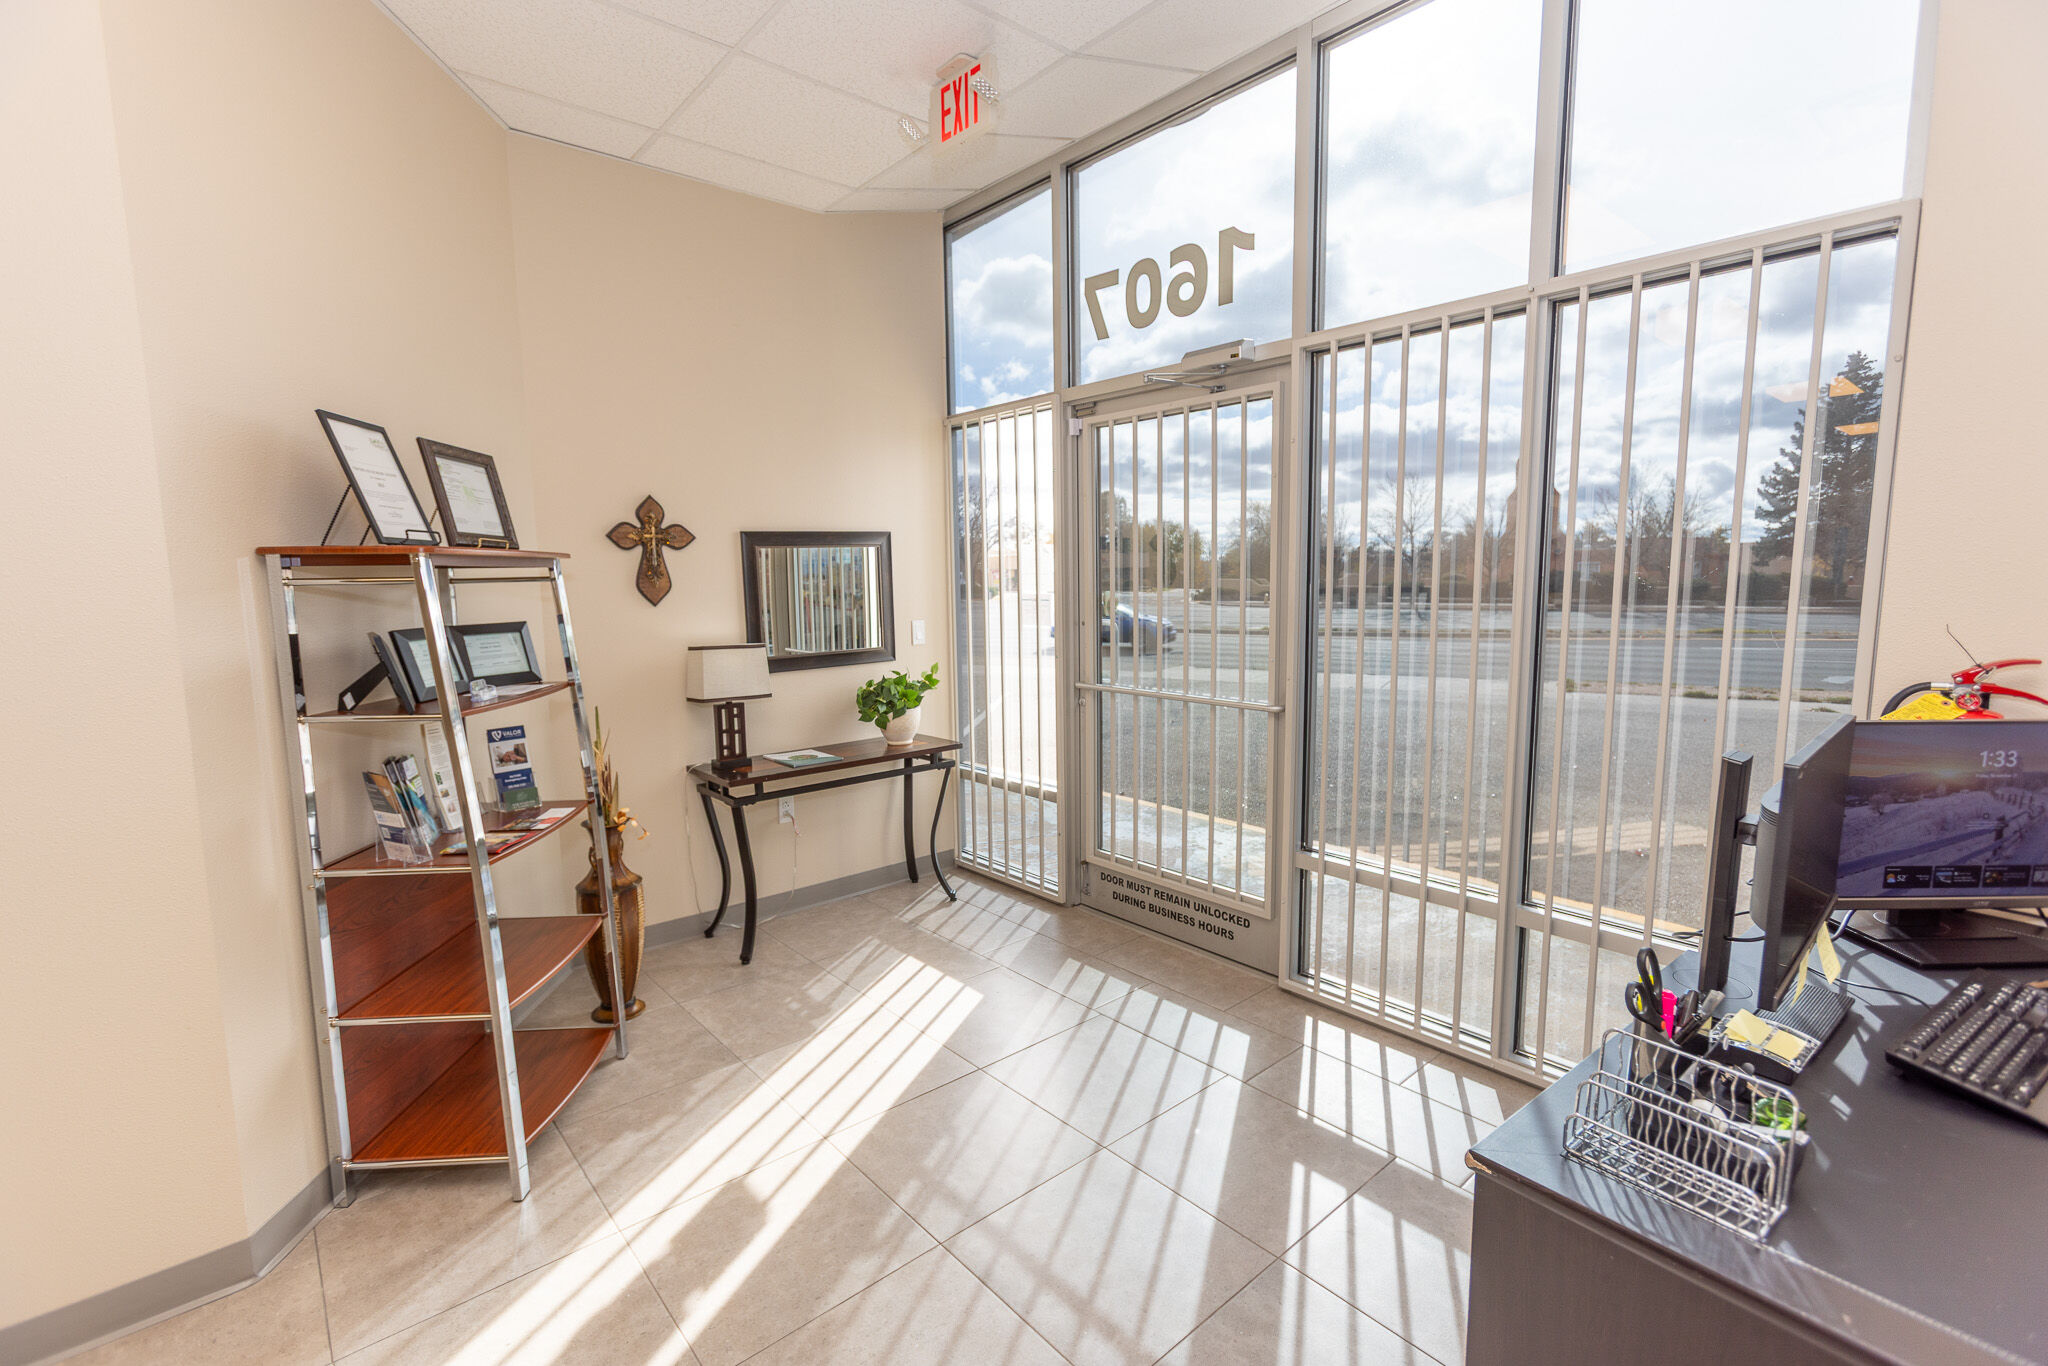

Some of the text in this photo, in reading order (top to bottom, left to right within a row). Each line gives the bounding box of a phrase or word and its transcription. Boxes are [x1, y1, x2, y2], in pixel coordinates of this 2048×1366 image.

[941, 63, 982, 143] EXIT
[1980, 750, 2018, 768] 1:33
[1100, 872, 1251, 929] DOOR MUST REMAIN UNLOCKED
[1112, 890, 1235, 941] DURING BUSINESS HOURS
